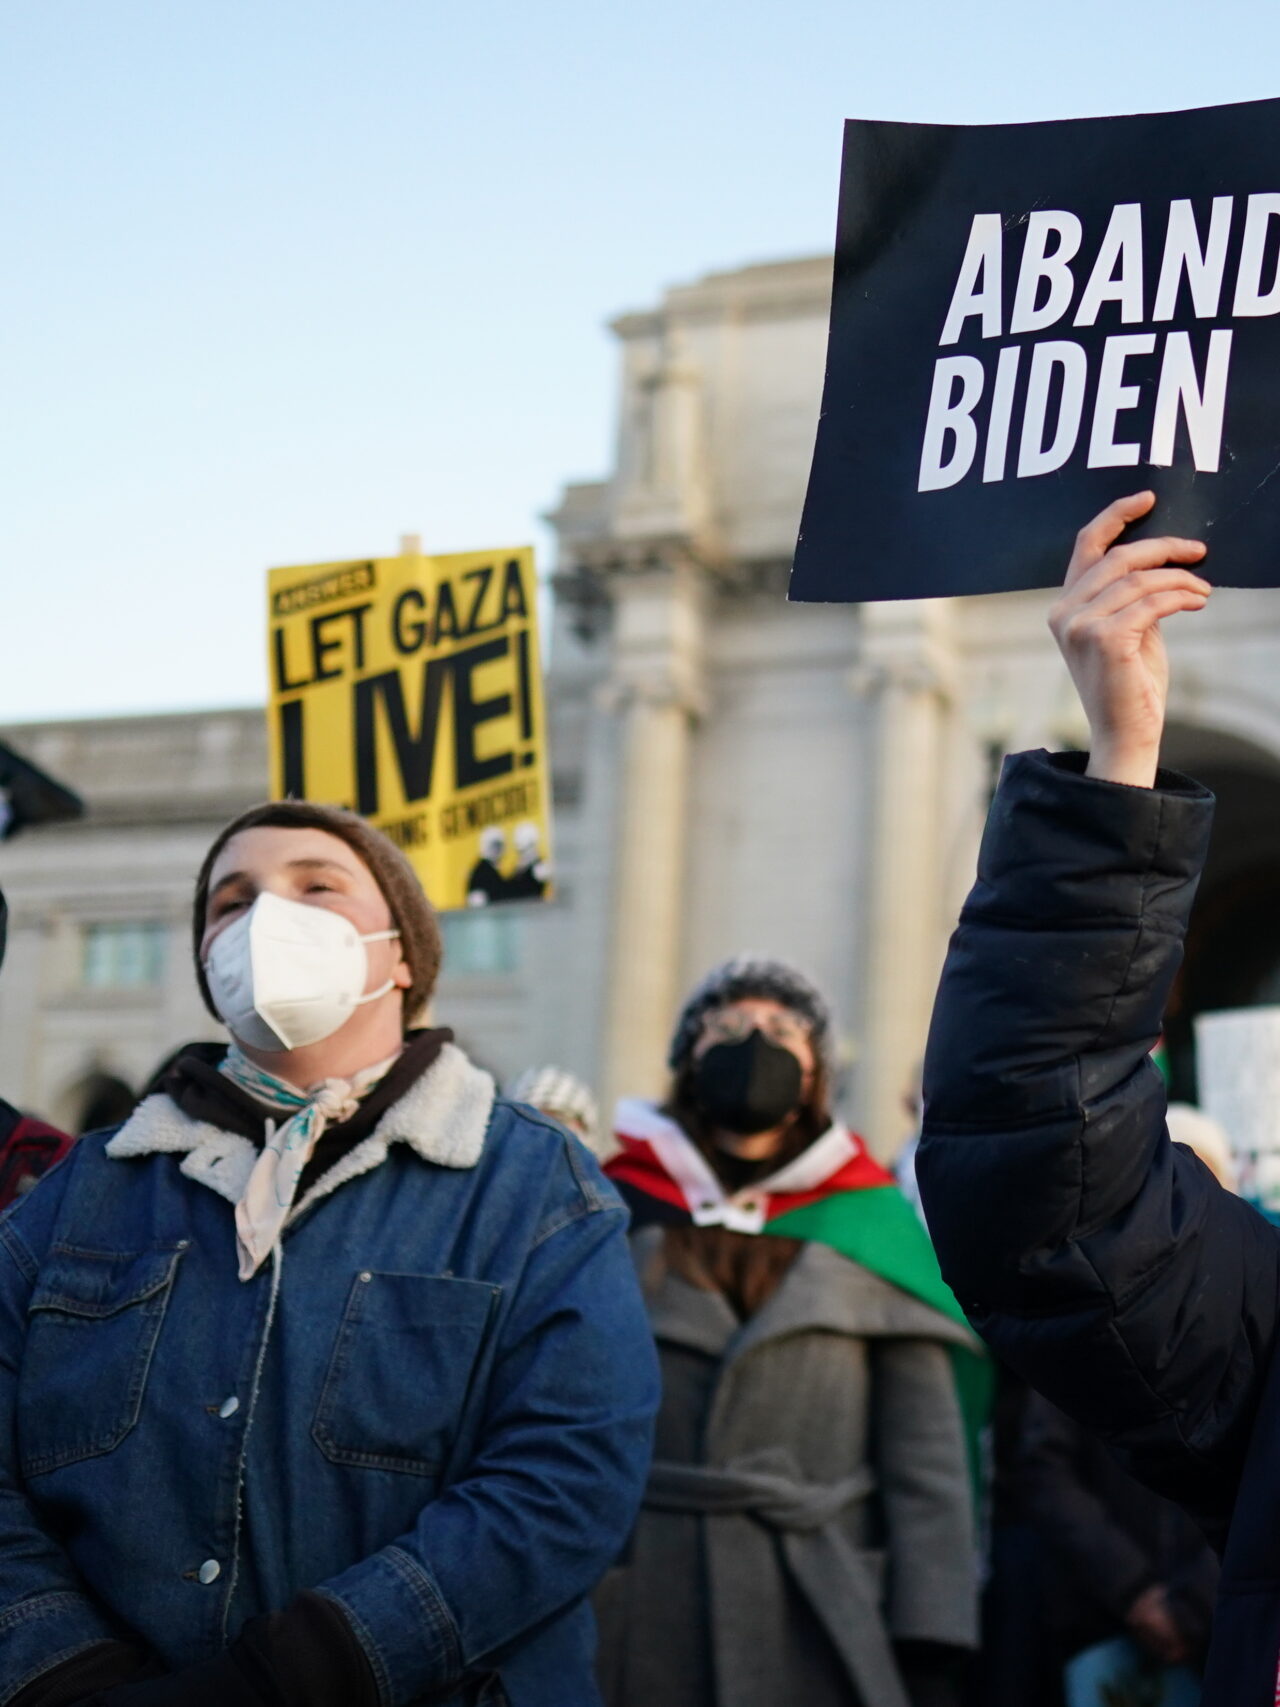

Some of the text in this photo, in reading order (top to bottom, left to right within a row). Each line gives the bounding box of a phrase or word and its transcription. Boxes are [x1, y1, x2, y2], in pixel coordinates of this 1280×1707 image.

[917, 329, 1234, 493] BIDEN
[274, 559, 529, 694] LET GAZA
